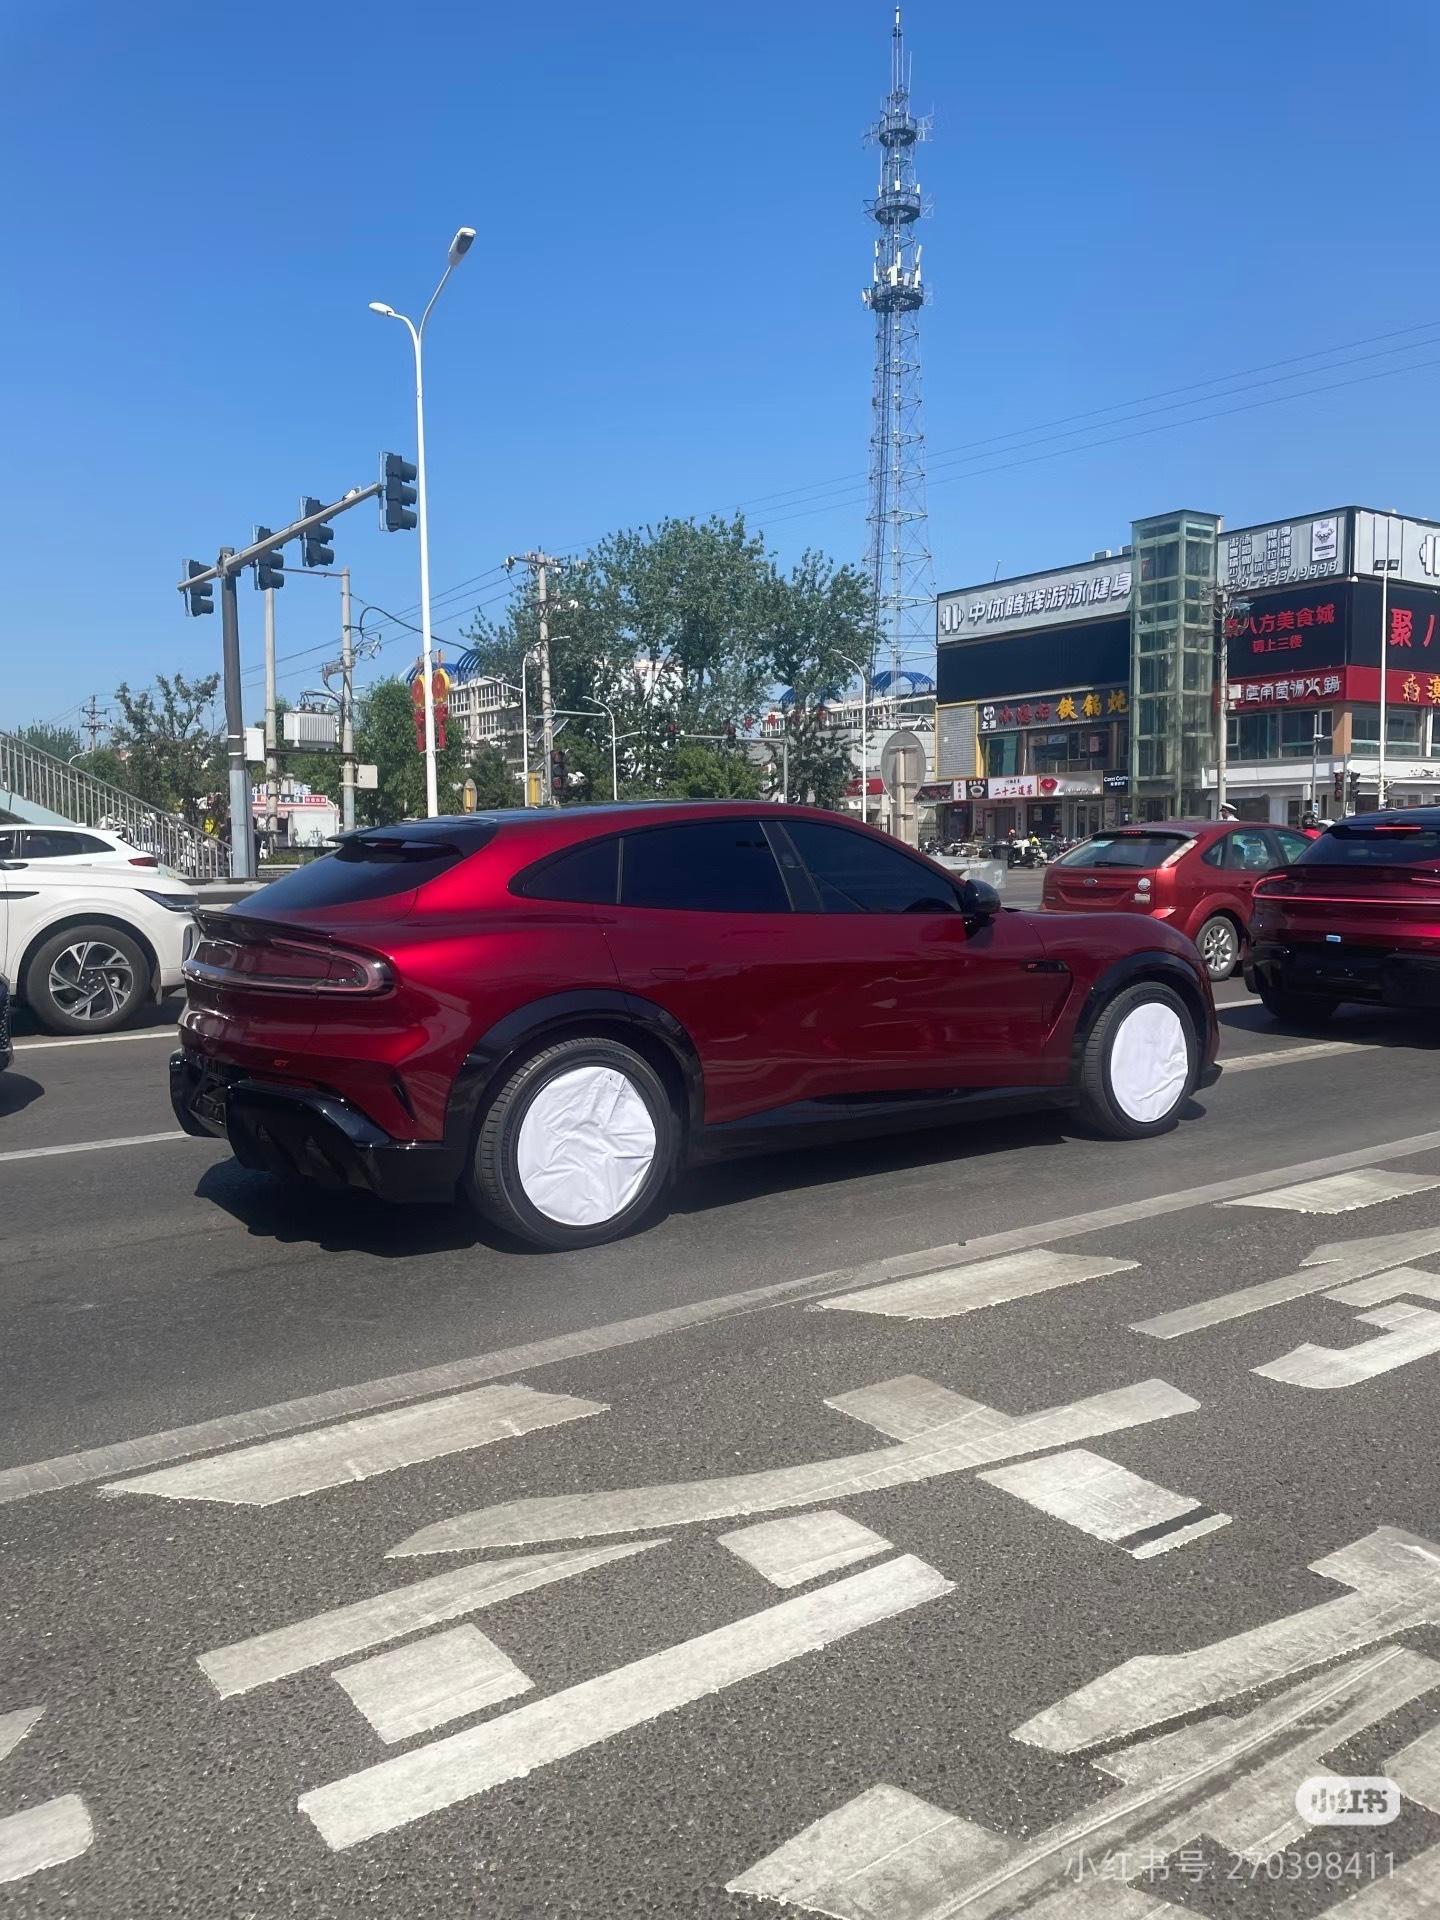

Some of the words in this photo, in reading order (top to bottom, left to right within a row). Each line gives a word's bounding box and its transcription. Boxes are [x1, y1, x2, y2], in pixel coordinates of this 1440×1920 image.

[967, 571, 1133, 623] 中体腾辉游泳健身
